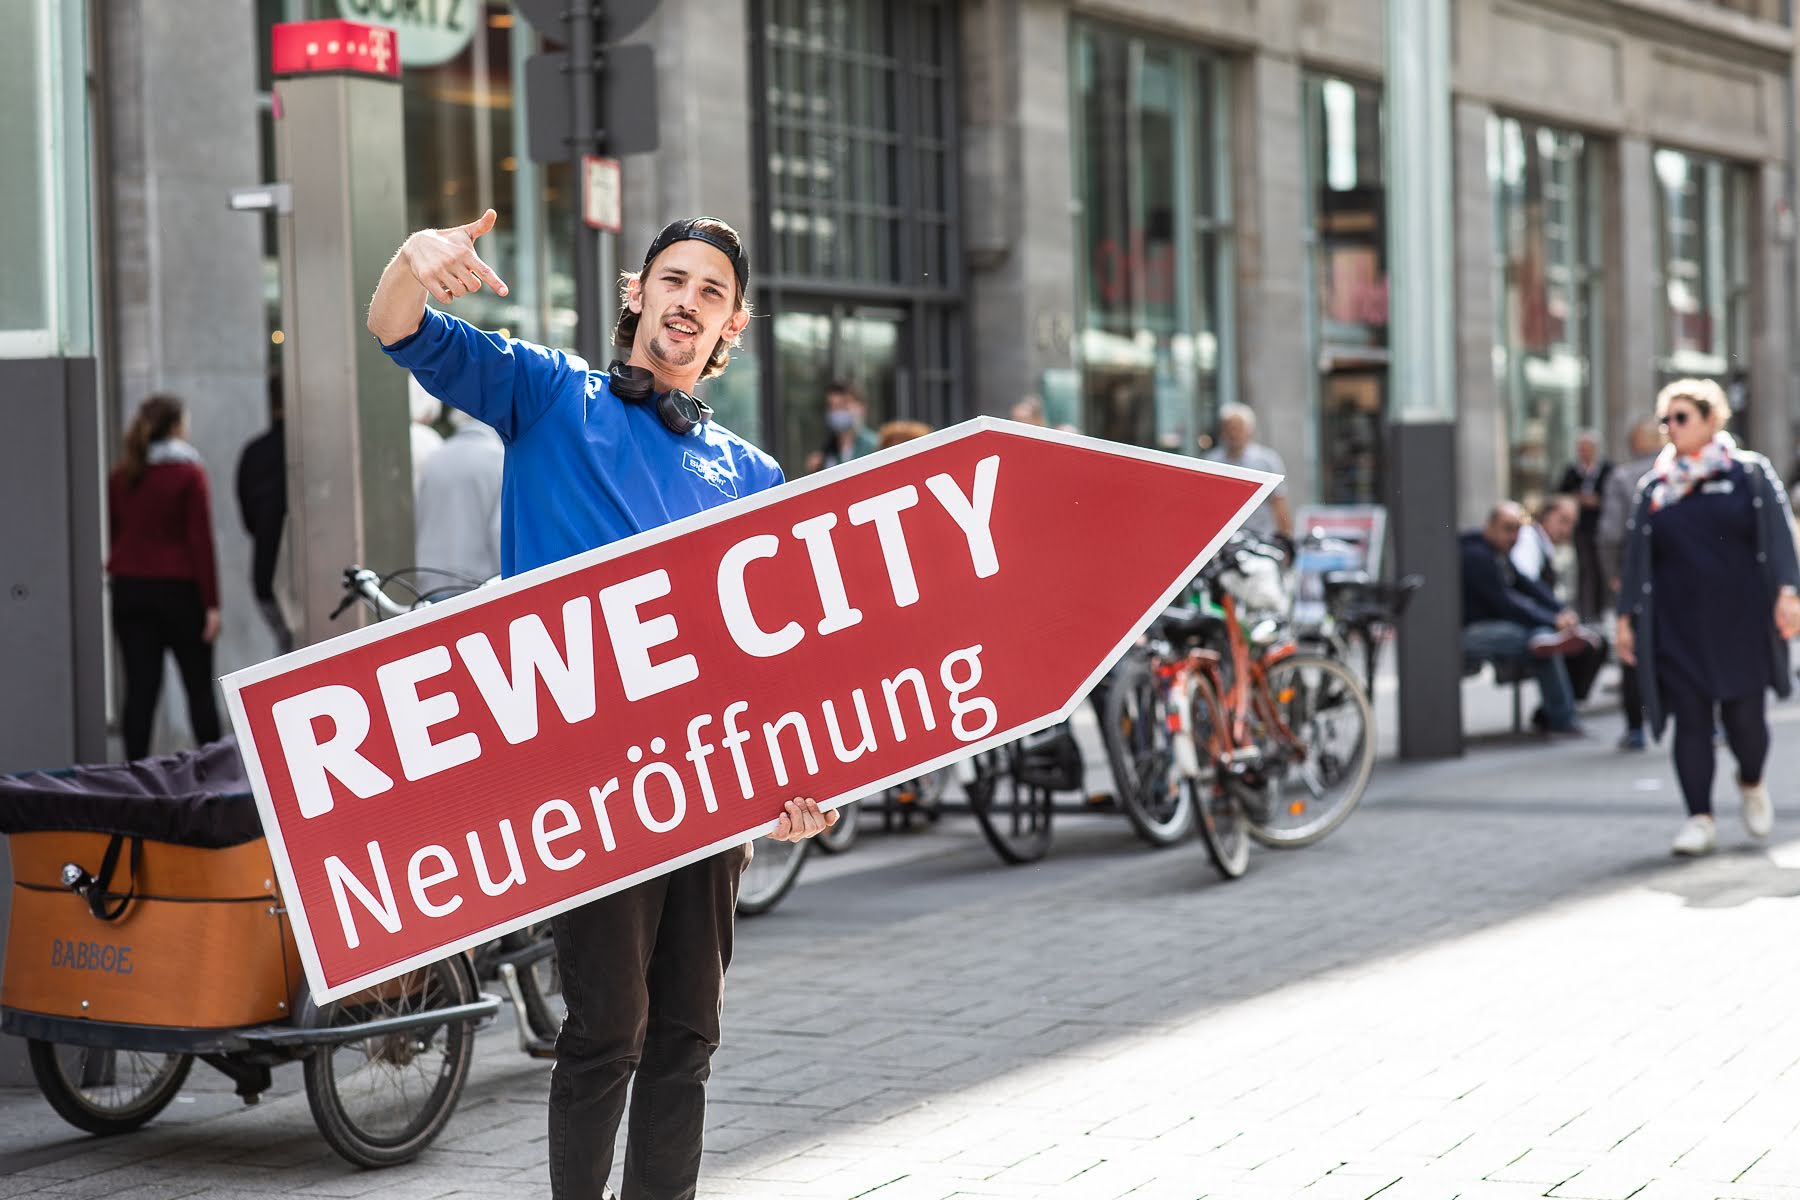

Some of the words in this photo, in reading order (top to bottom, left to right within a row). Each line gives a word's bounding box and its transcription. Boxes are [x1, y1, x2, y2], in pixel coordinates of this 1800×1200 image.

[272, 568, 700, 819] REWE
[717, 454, 1000, 658] CITY
[323, 644, 998, 949] Neueröffnung
[51, 938, 134, 975] BABBOE
